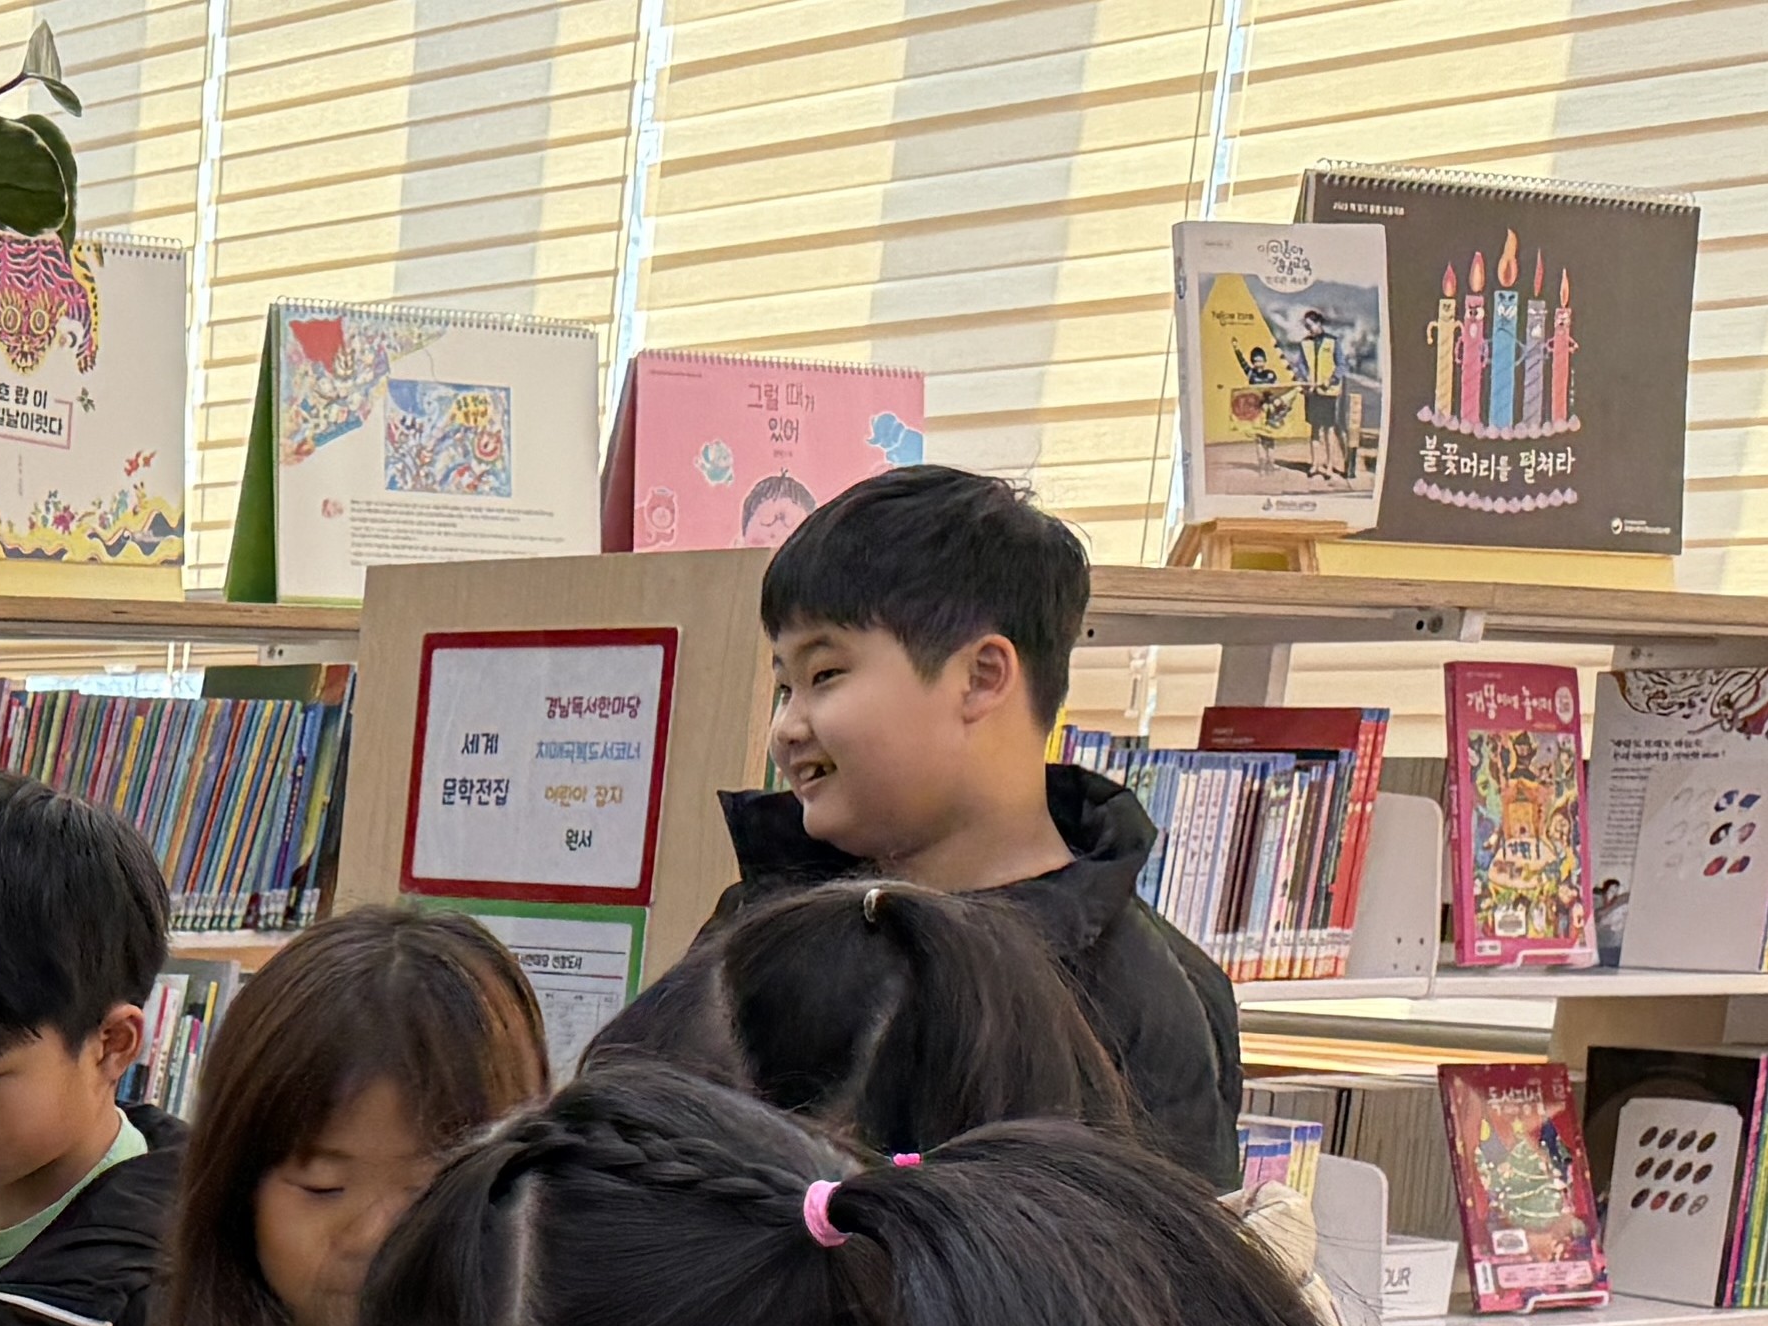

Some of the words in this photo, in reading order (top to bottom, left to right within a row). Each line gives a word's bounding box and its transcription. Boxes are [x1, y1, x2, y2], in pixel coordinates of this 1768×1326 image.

[747, 383, 779, 411] 그럴
[768, 417, 799, 443] 있어
[1419, 435, 1512, 481] 불꽃머리를
[1518, 446, 1576, 484] 펼쳐라
[544, 696, 641, 719] 경남독서한마당
[461, 733, 499, 754] 세계
[442, 777, 510, 806] 문학전집
[544, 785, 587, 807] 어린이
[594, 785, 623, 808] 잡지
[564, 829, 593, 851] 원서
